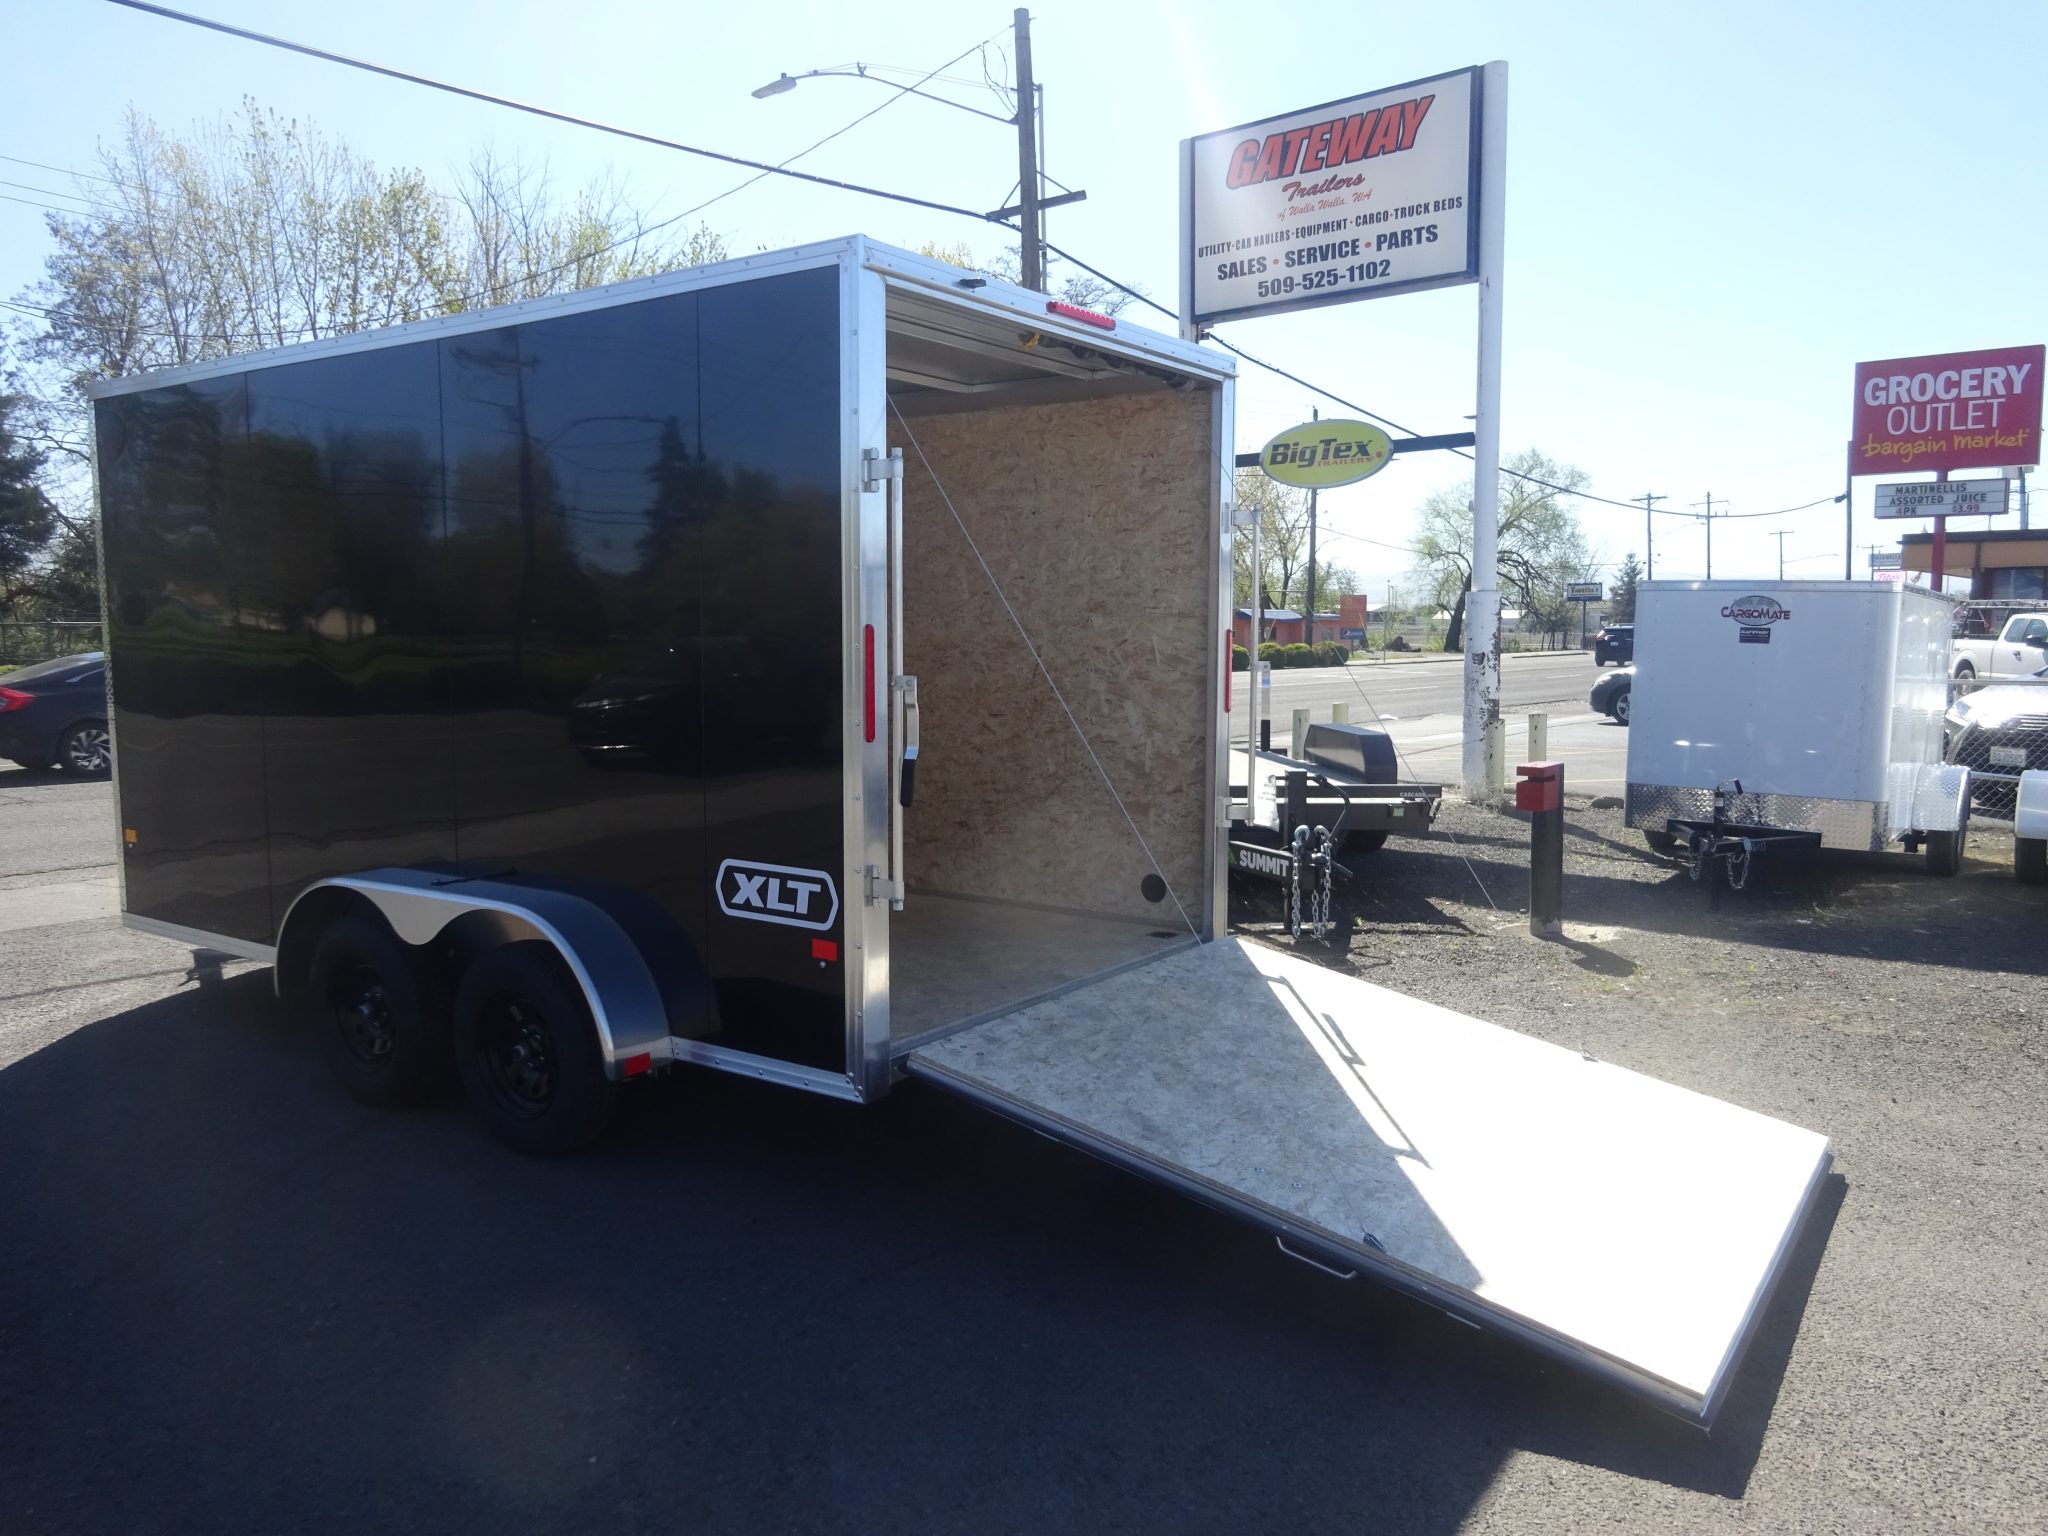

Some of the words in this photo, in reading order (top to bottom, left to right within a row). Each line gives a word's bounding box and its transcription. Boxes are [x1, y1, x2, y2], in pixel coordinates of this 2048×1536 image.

[1226, 94, 1436, 190] GATEWAY
[1282, 173, 1366, 202] Trailers
[1198, 240, 1232, 258] UTILITY
[1235, 237, 1251, 250] CAR
[1254, 230, 1291, 247] HAULERS
[1295, 218, 1348, 239] EQUIPMENT
[1355, 210, 1389, 227] CARGO
[1394, 202, 1431, 220] TRUCK
[1433, 196, 1463, 213] BEDS
[1277, 210, 1286, 222] of
[1289, 204, 1315, 217] Walla
[1217, 256, 1268, 281] SALES
[1284, 238, 1361, 268] SERVICE
[1376, 224, 1438, 252] PARTS
[1257, 258, 1391, 298] 509-525-1102
[1863, 363, 2031, 407] GROCERY
[1886, 397, 2006, 436] OUTLET
[1317, 456, 1373, 467] TRAILERS
[1861, 433, 1947, 463] bargain
[1953, 429, 2028, 450] market
[1889, 495, 1944, 506] ASSORTED
[1953, 493, 1987, 503] JUICE
[1895, 483, 1967, 495] MARTINELLIS
[1952, 504, 1980, 513] $3.99
[1239, 849, 1289, 877] SUMMIT
[731, 872, 822, 915] XLT
